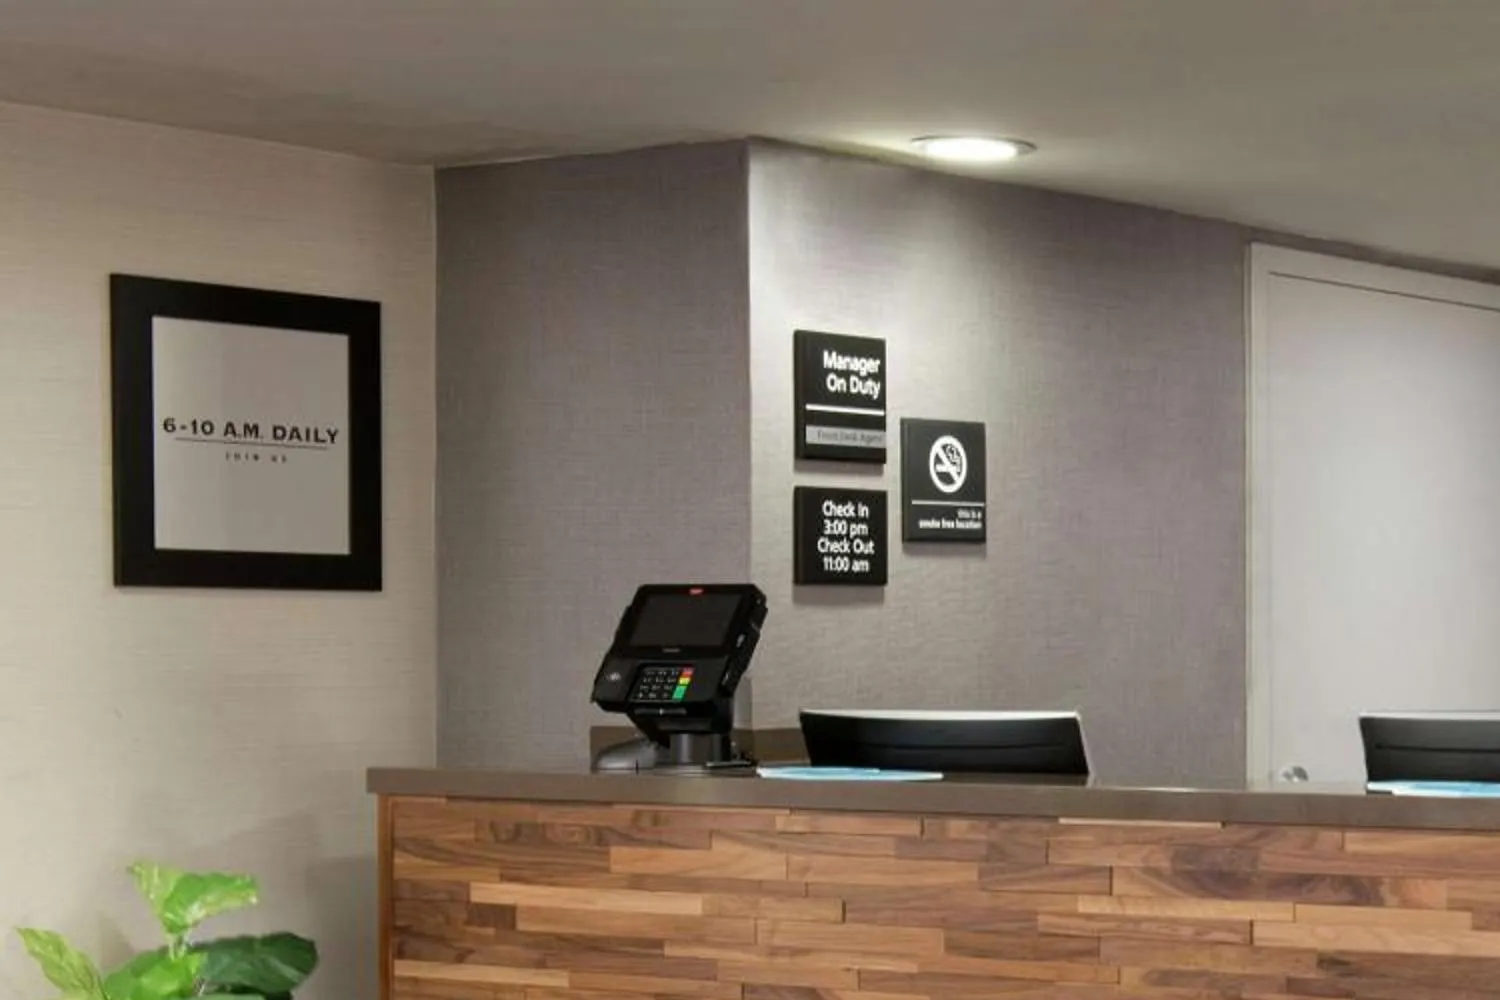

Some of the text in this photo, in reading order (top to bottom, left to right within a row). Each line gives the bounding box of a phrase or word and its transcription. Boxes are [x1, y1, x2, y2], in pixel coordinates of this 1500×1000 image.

[823, 350, 881, 376] Manager
[826, 373, 881, 400] On Duty
[163, 417, 215, 435] 6-10
[273, 425, 340, 444] DAILY
[822, 500, 870, 518] Check In
[824, 520, 869, 538] 3:00 pm
[817, 537, 875, 555] Check Out
[823, 557, 870, 573] 11:00 am
